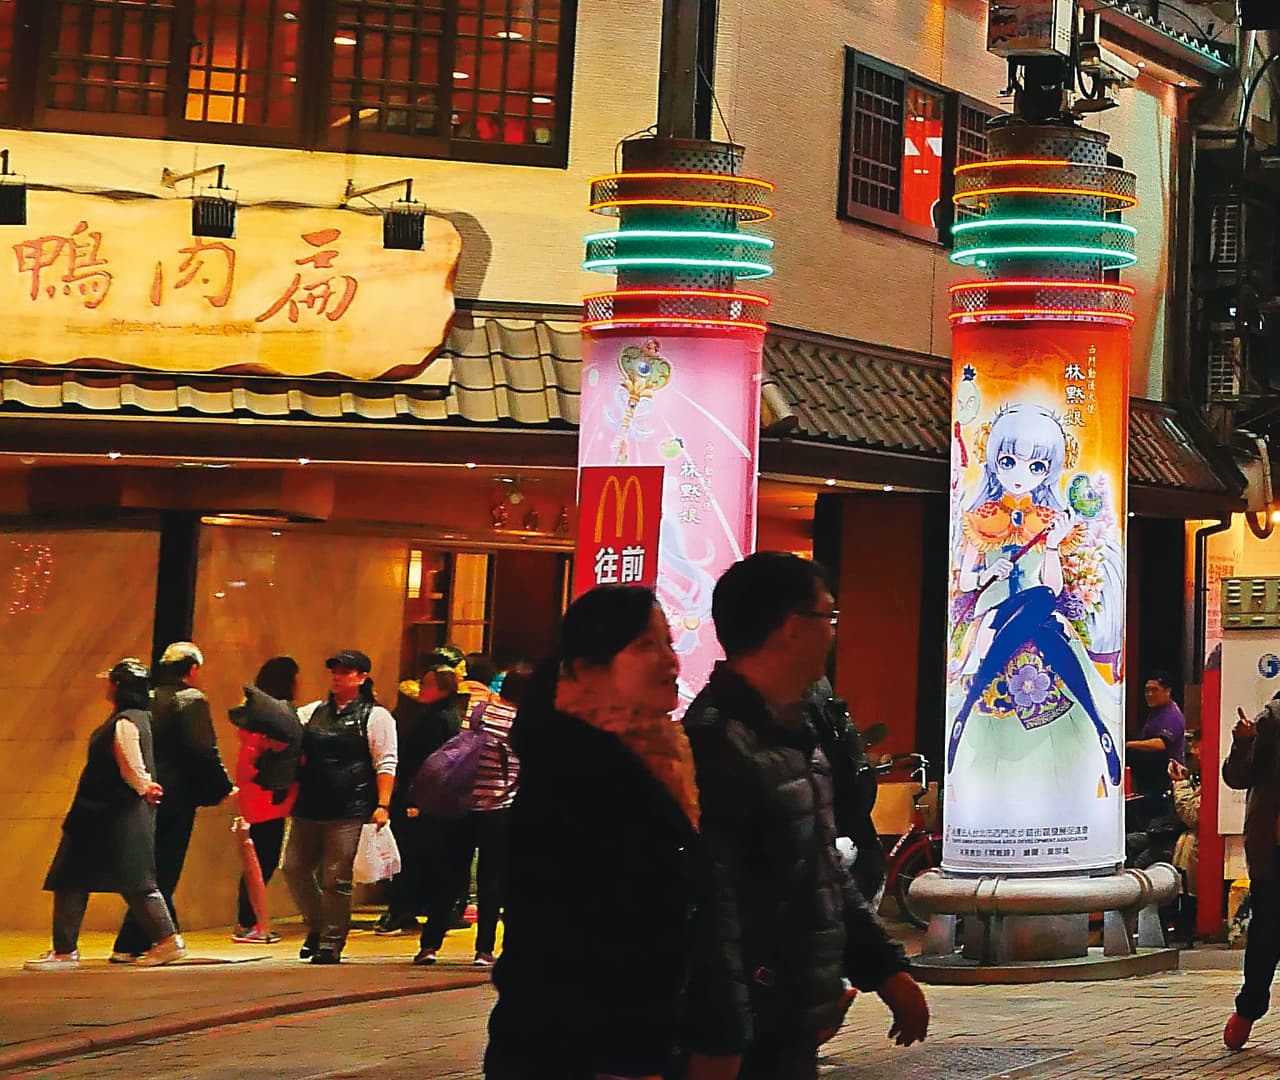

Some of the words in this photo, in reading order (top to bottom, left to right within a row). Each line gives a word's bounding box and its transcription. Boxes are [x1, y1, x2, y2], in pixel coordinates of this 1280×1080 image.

[12, 220, 358, 323] 鴨肉扁
[594, 546, 645, 585] 往前
